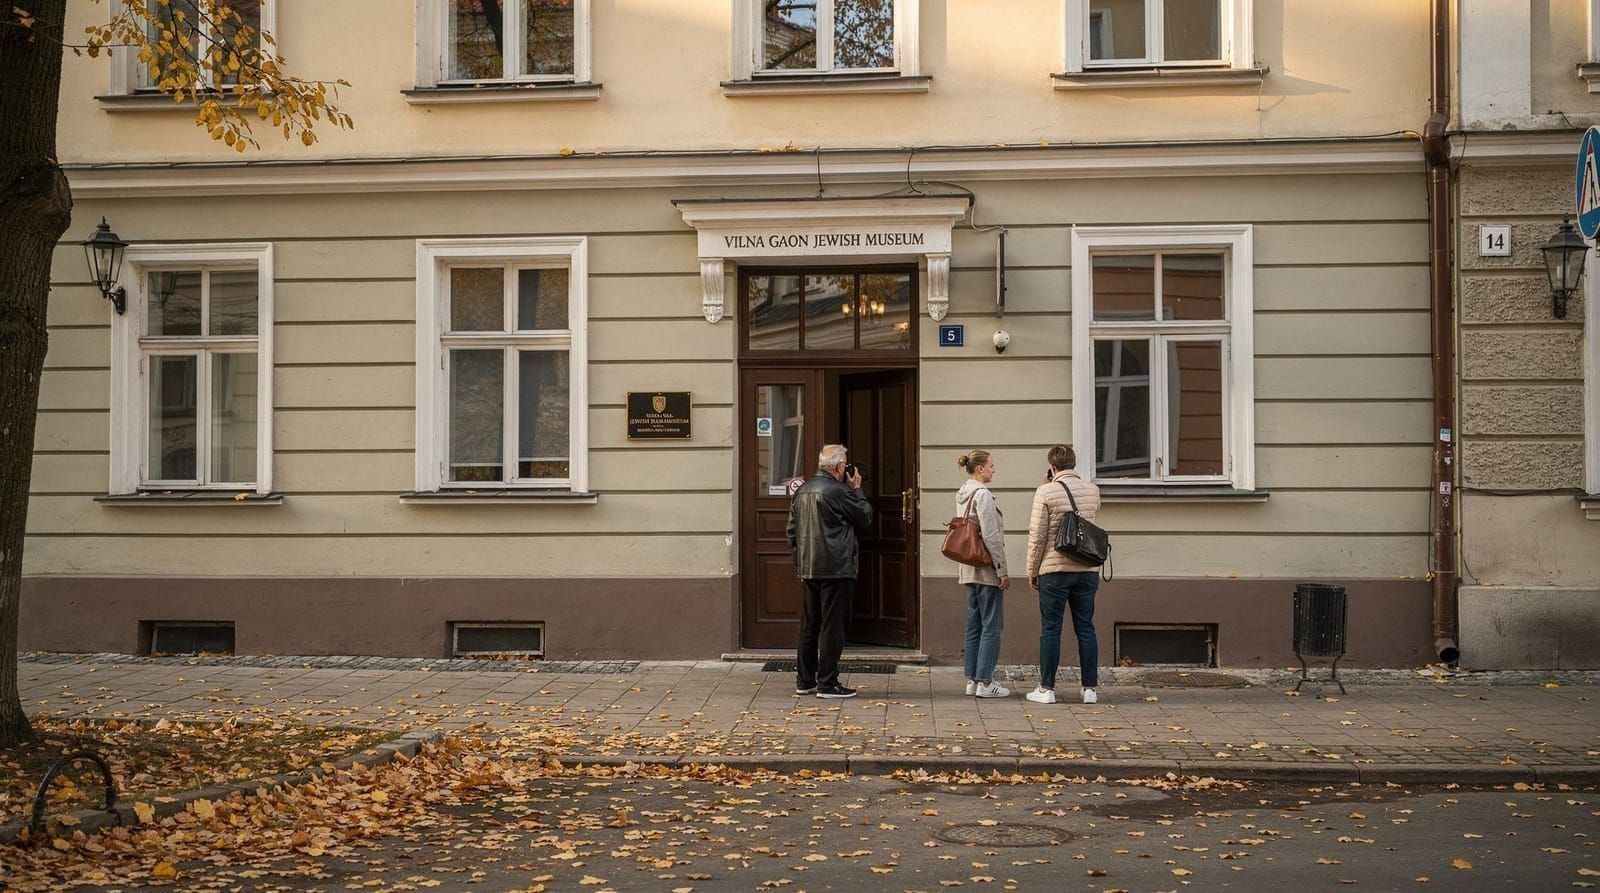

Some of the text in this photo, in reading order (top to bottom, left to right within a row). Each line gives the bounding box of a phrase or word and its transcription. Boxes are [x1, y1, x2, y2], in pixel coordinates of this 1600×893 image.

[724, 232, 924, 248] VILNA GAON JEWISH MUSEUM
[1486, 233, 1504, 249] 14
[947, 330, 955, 341] 5
